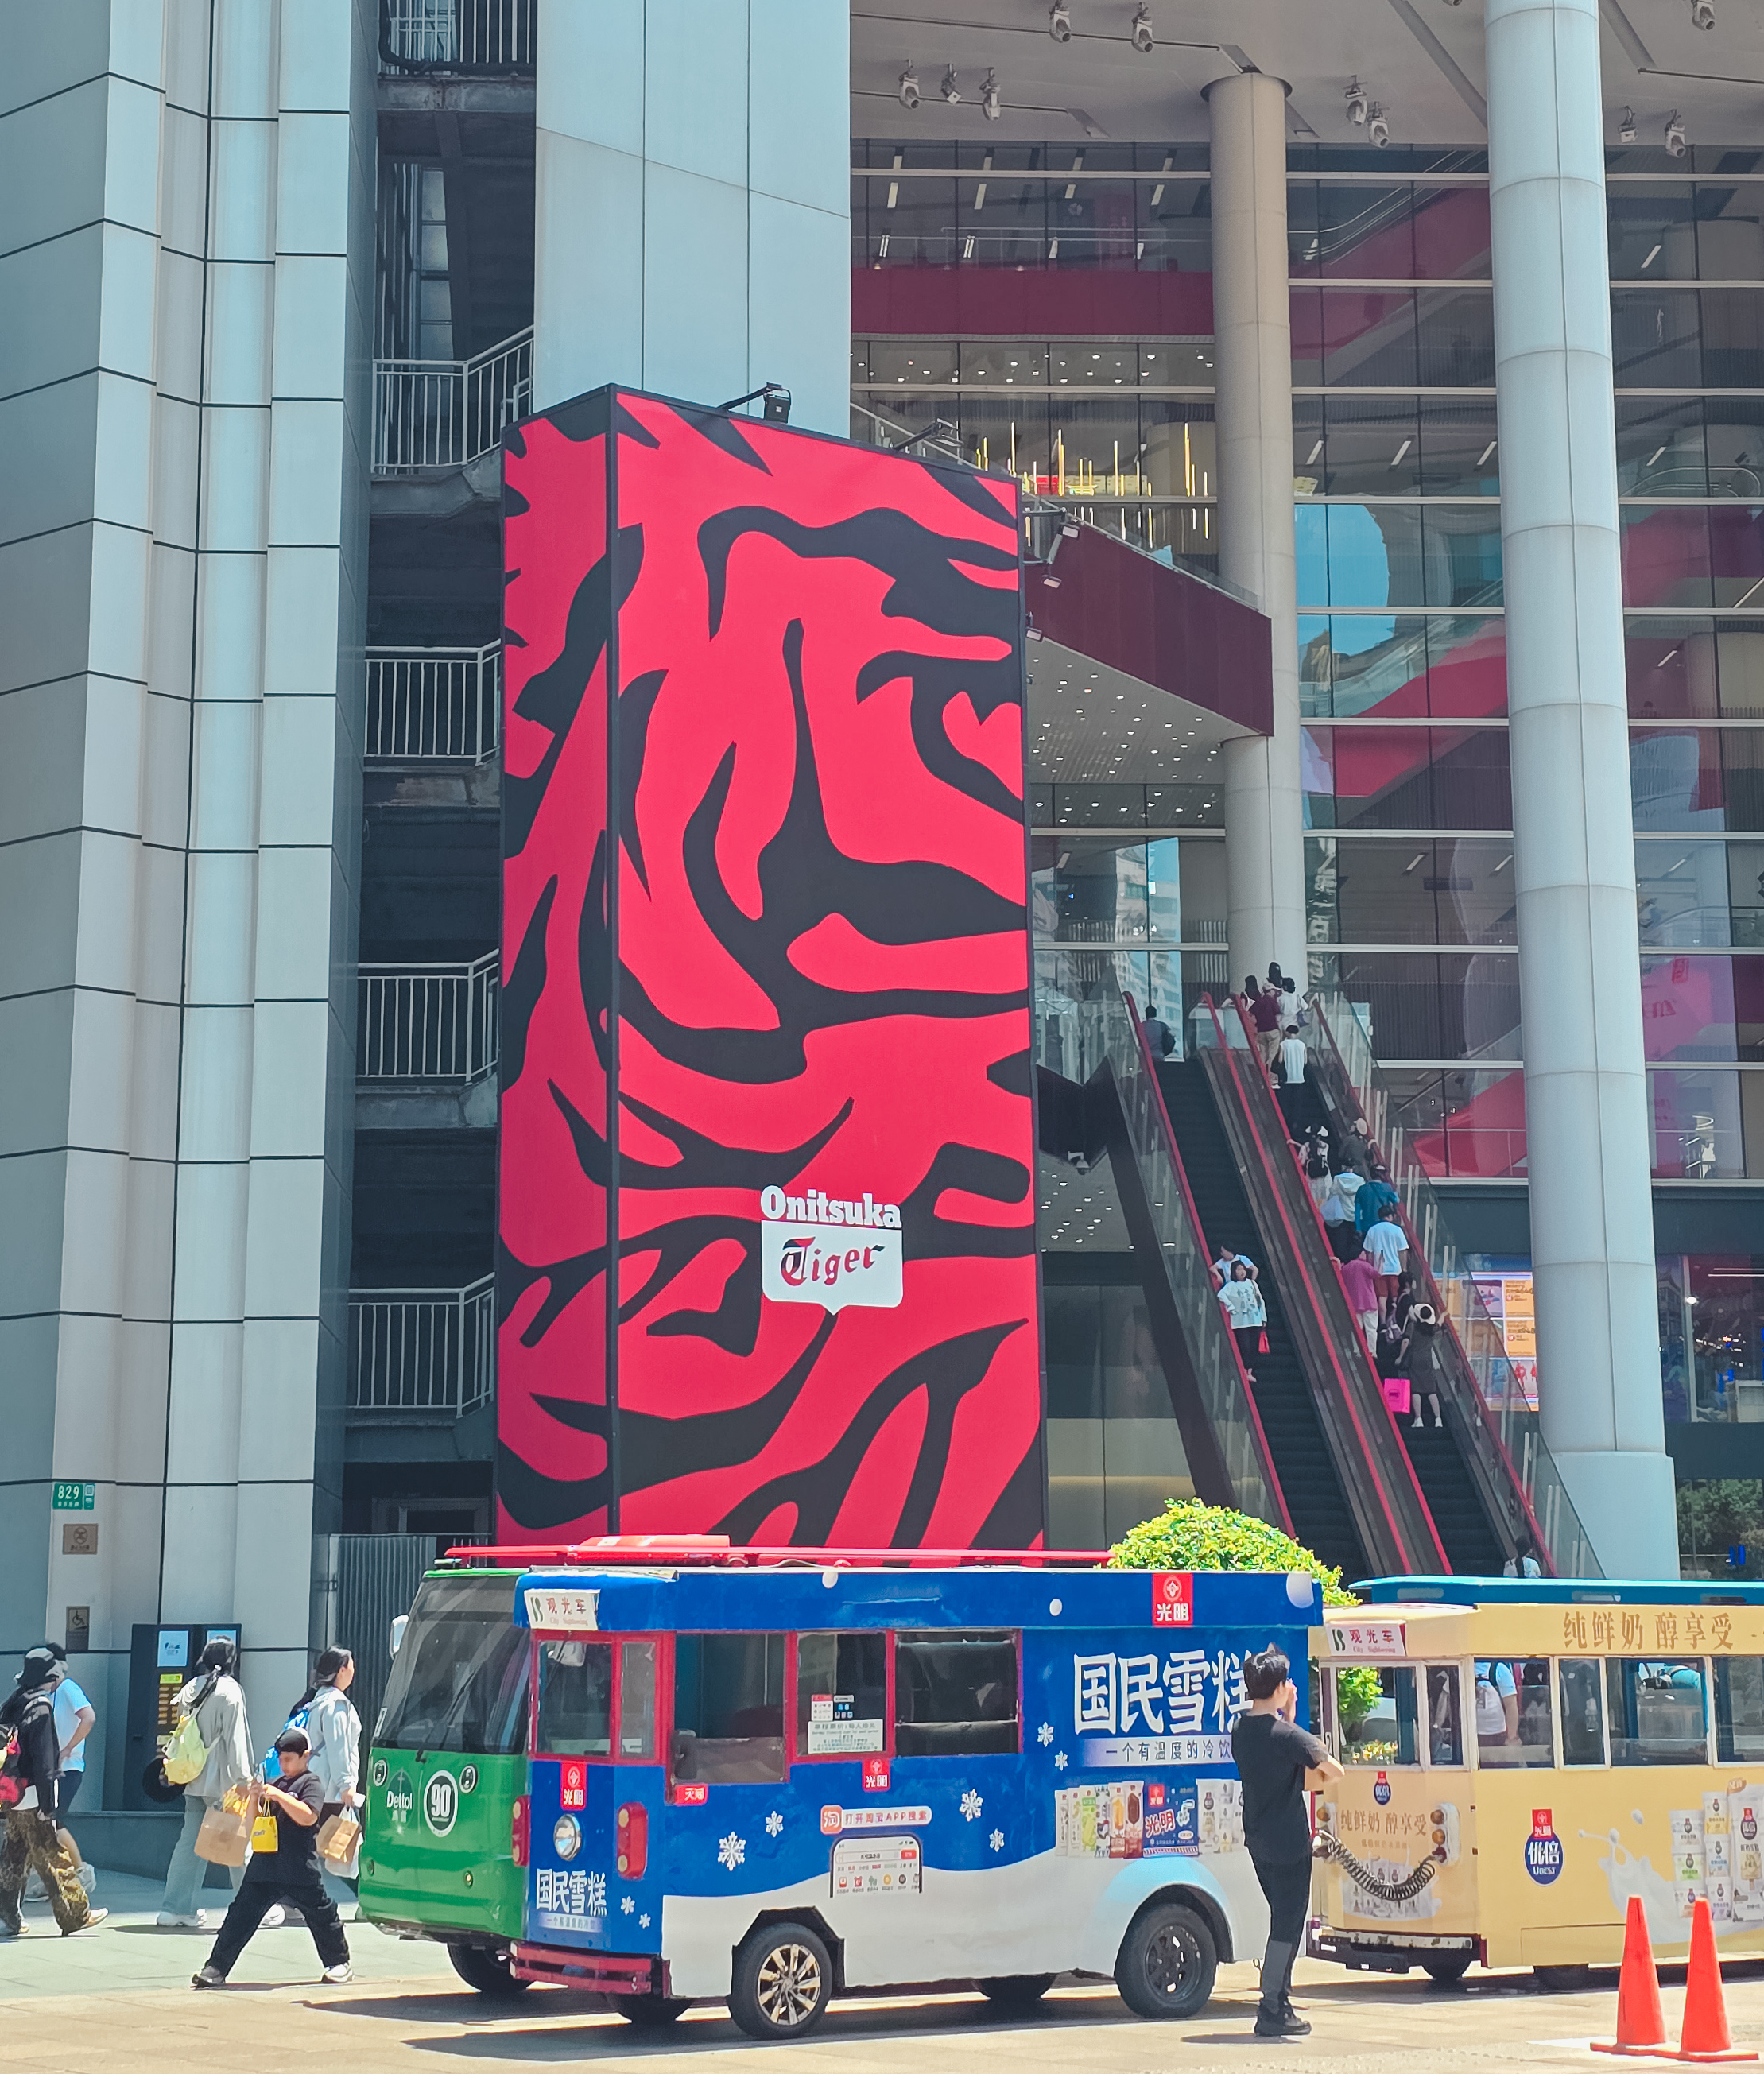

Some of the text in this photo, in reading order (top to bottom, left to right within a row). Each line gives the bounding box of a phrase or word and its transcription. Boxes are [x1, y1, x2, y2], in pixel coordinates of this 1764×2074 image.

[761, 1185, 901, 1228] Onitsuka
[781, 1236, 885, 1286] Tiger
[58, 1485, 79, 1500] 829
[1156, 1603, 1189, 1622] 光明
[1349, 1628, 1394, 1644] 观光车
[1563, 1611, 1734, 1650] 纯鲜奶 醇享受
[1106, 1739, 1231, 1762] 一个有温度的冷饮
[866, 1774, 888, 1788] 光明
[387, 1791, 413, 1809] Dettol
[431, 1784, 452, 1817] 90
[564, 1789, 584, 1805] 光明
[824, 1811, 840, 1828] 淘
[1146, 1808, 1175, 1838] 光明
[1341, 1810, 1427, 1836] 纯鲜奶 醇享受
[1528, 1841, 1560, 1864] 优倍
[537, 1868, 607, 1916] 国民雪糕
